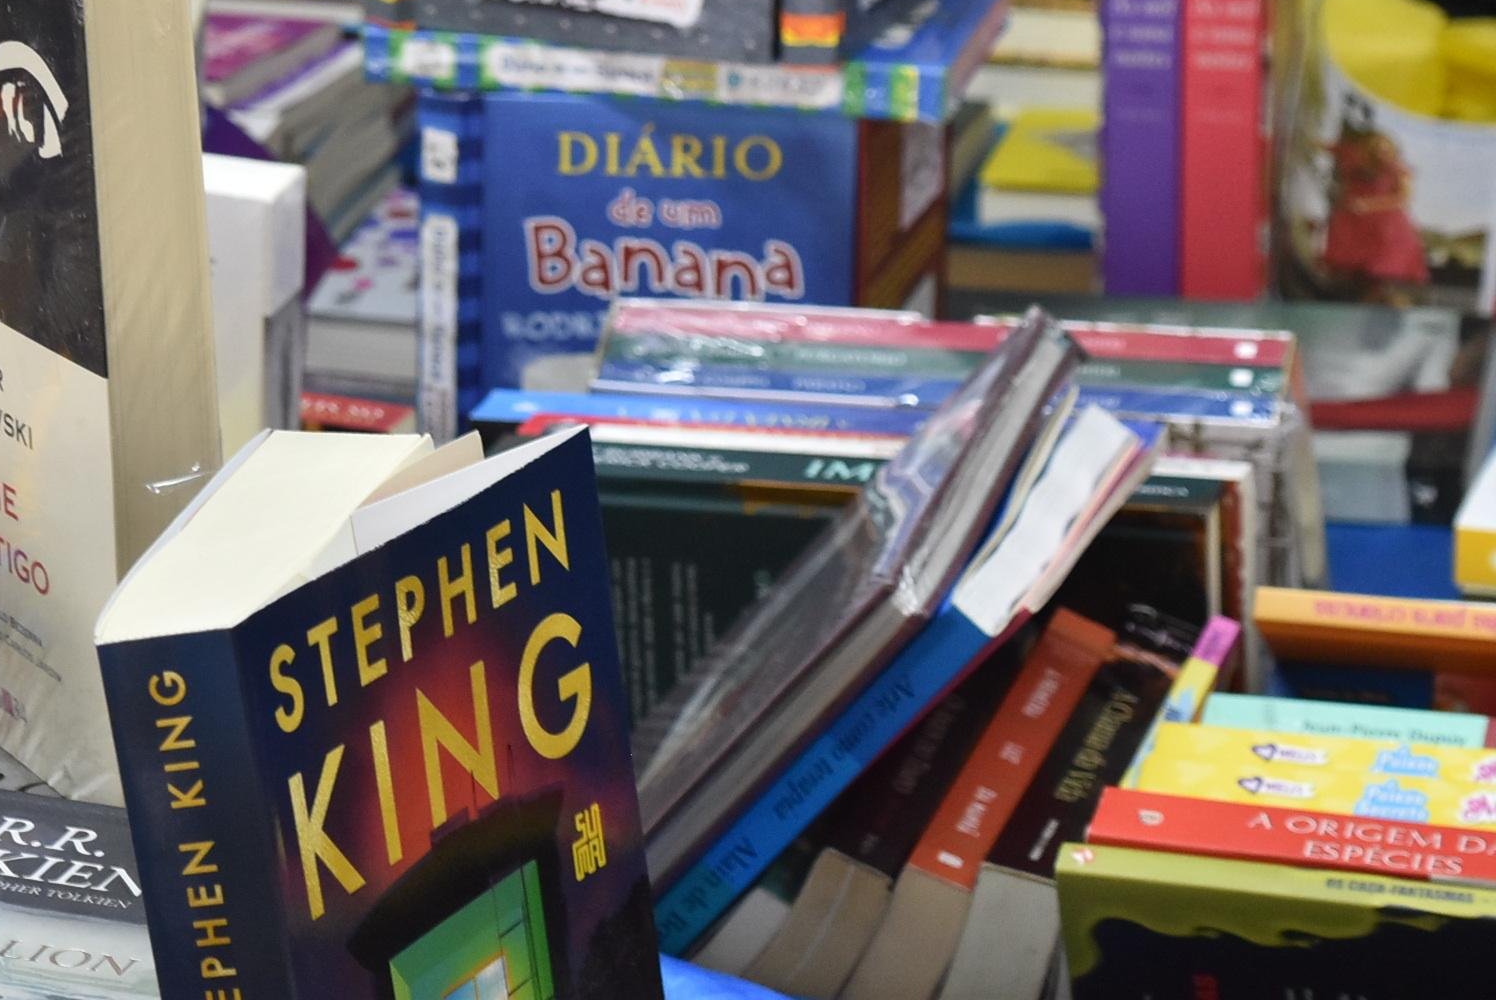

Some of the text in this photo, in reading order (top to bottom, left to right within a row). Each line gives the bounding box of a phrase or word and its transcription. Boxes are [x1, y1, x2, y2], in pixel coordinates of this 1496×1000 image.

[556, 120, 784, 182] DIÁRIO
[607, 188, 722, 229] de um
[524, 215, 803, 302] Banana
[268, 488, 572, 734] STEPHEN
[287, 611, 593, 922] KING
[148, 668, 243, 1000] EPHEN KING
[1247, 811, 1273, 831] A
[1284, 814, 1443, 850] ORIGEM
[1303, 838, 1464, 875] ESPÉCIES
